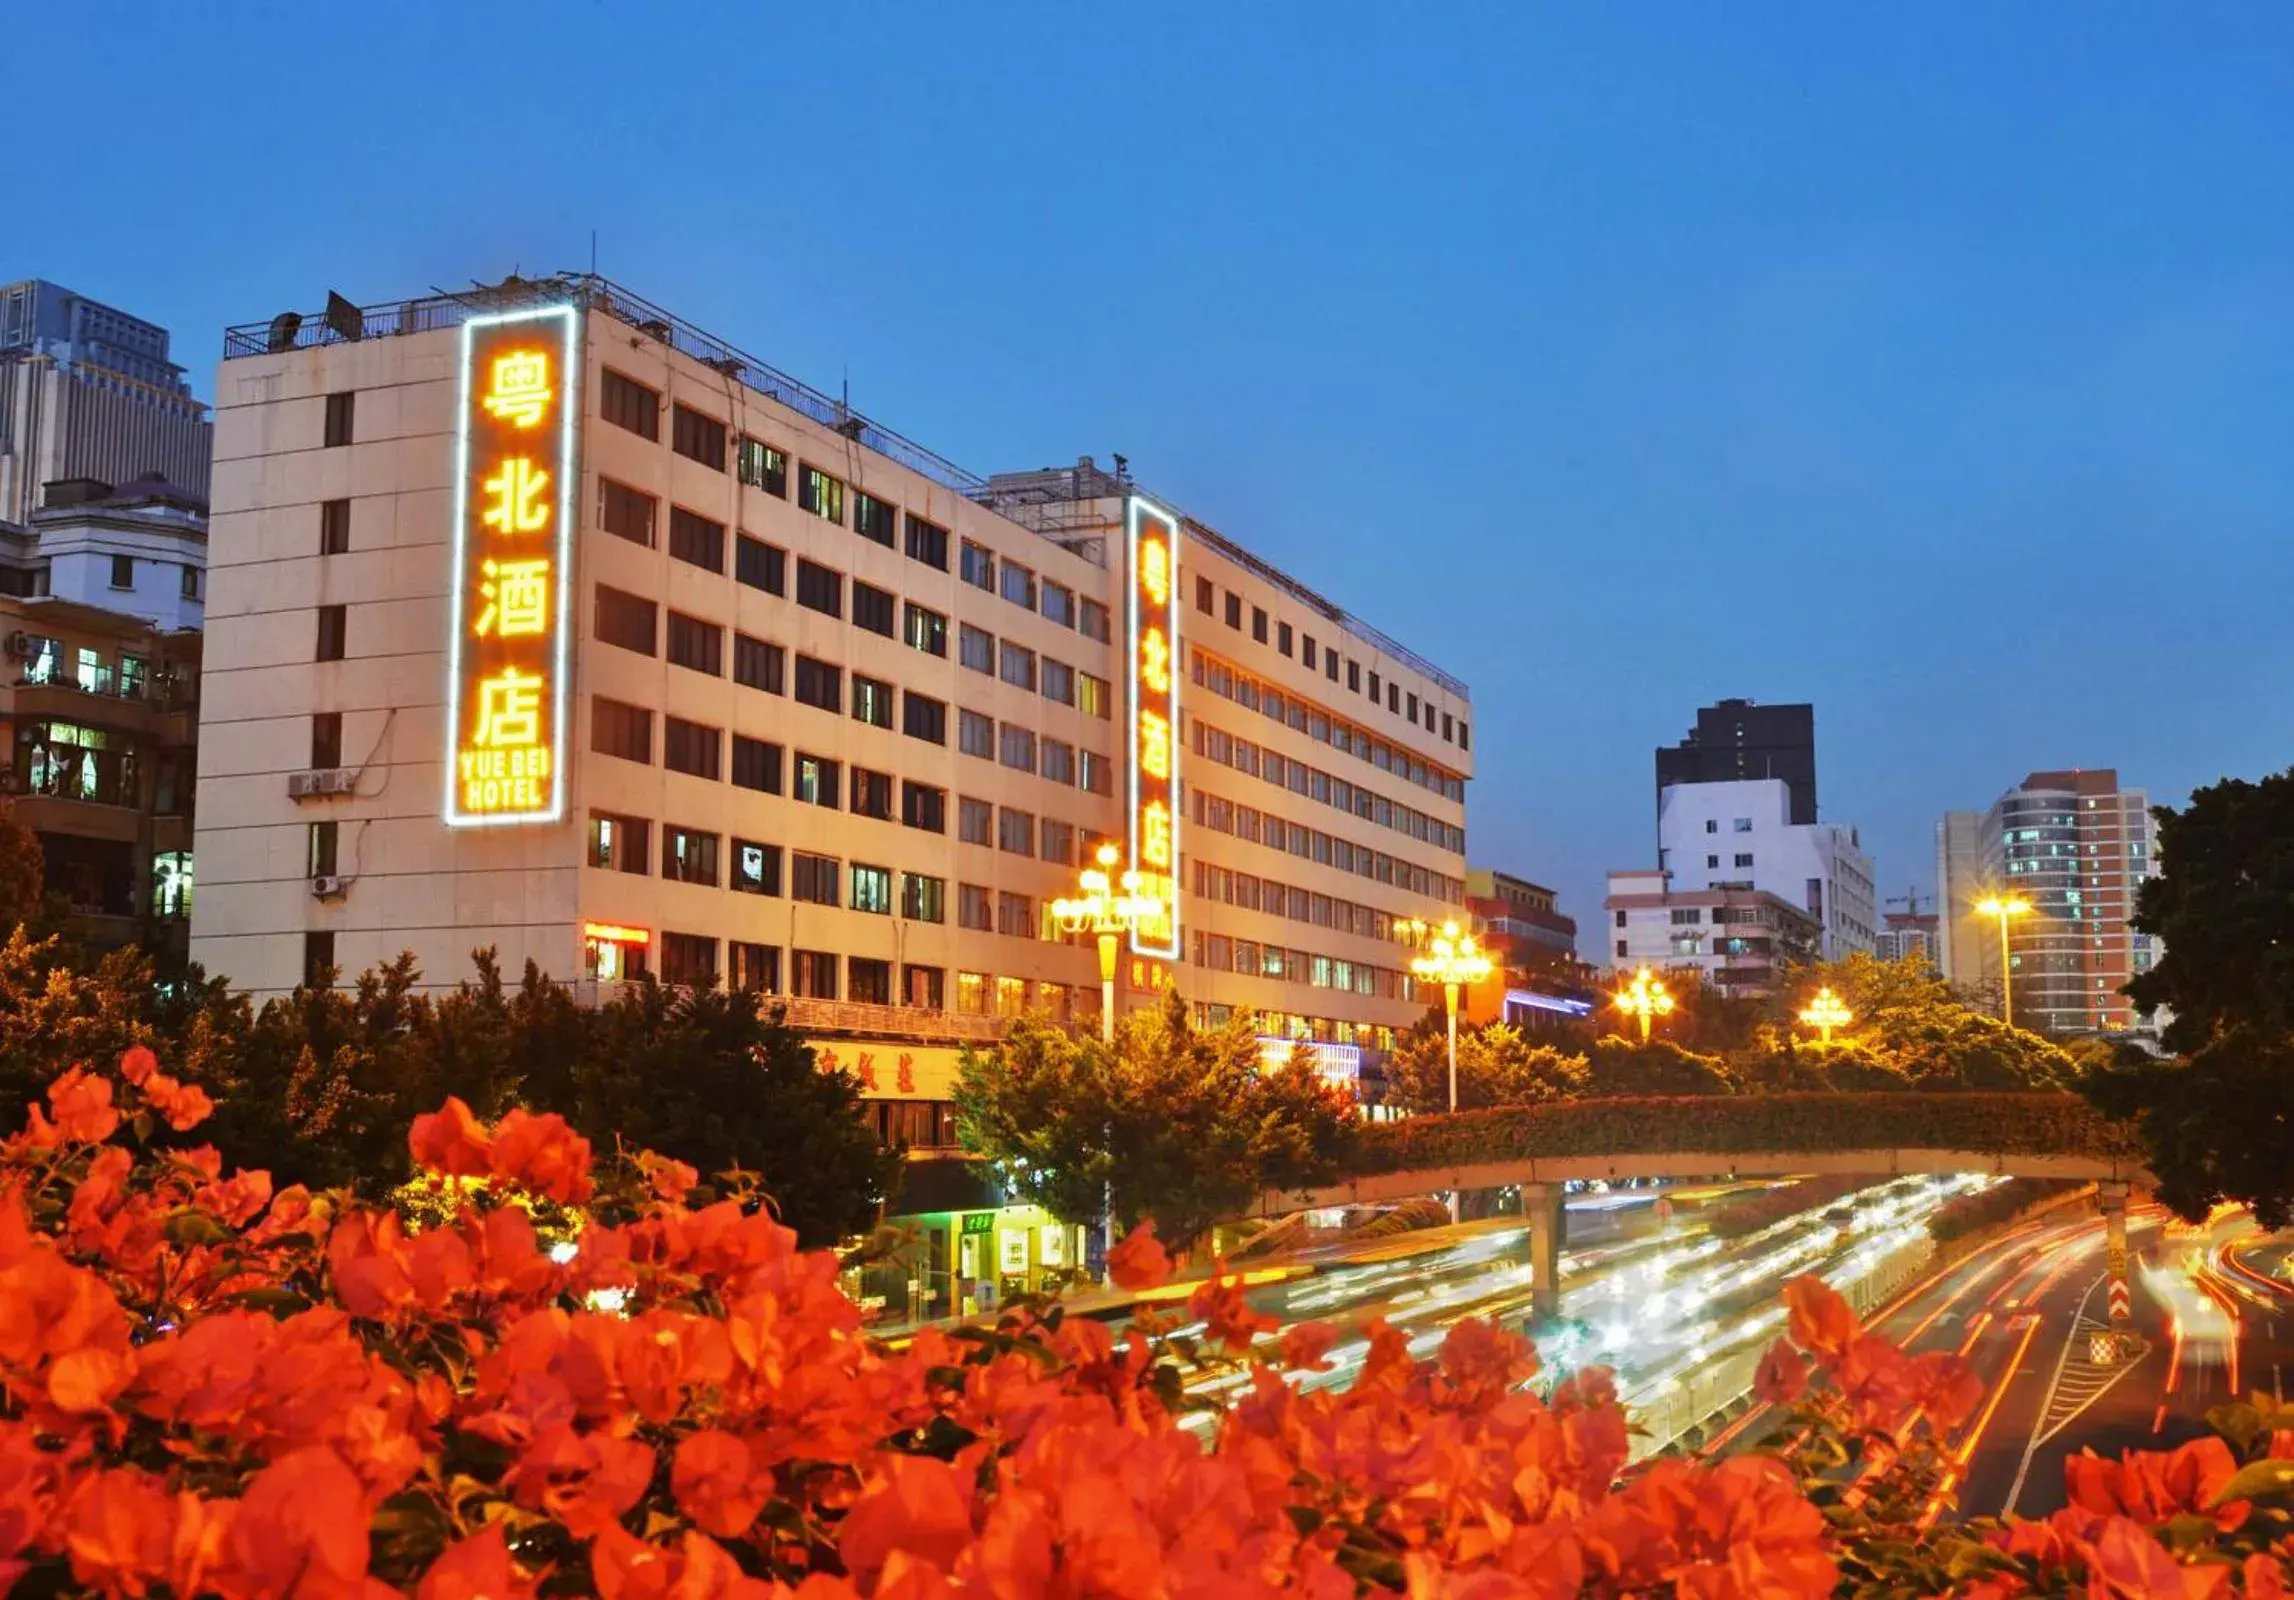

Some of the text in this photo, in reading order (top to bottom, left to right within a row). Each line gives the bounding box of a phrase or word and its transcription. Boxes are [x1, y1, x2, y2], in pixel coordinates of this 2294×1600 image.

[474, 350, 551, 748] 粤北酒店
[460, 747, 549, 779] YUE BEI
[465, 778, 542, 809] HOTEL
